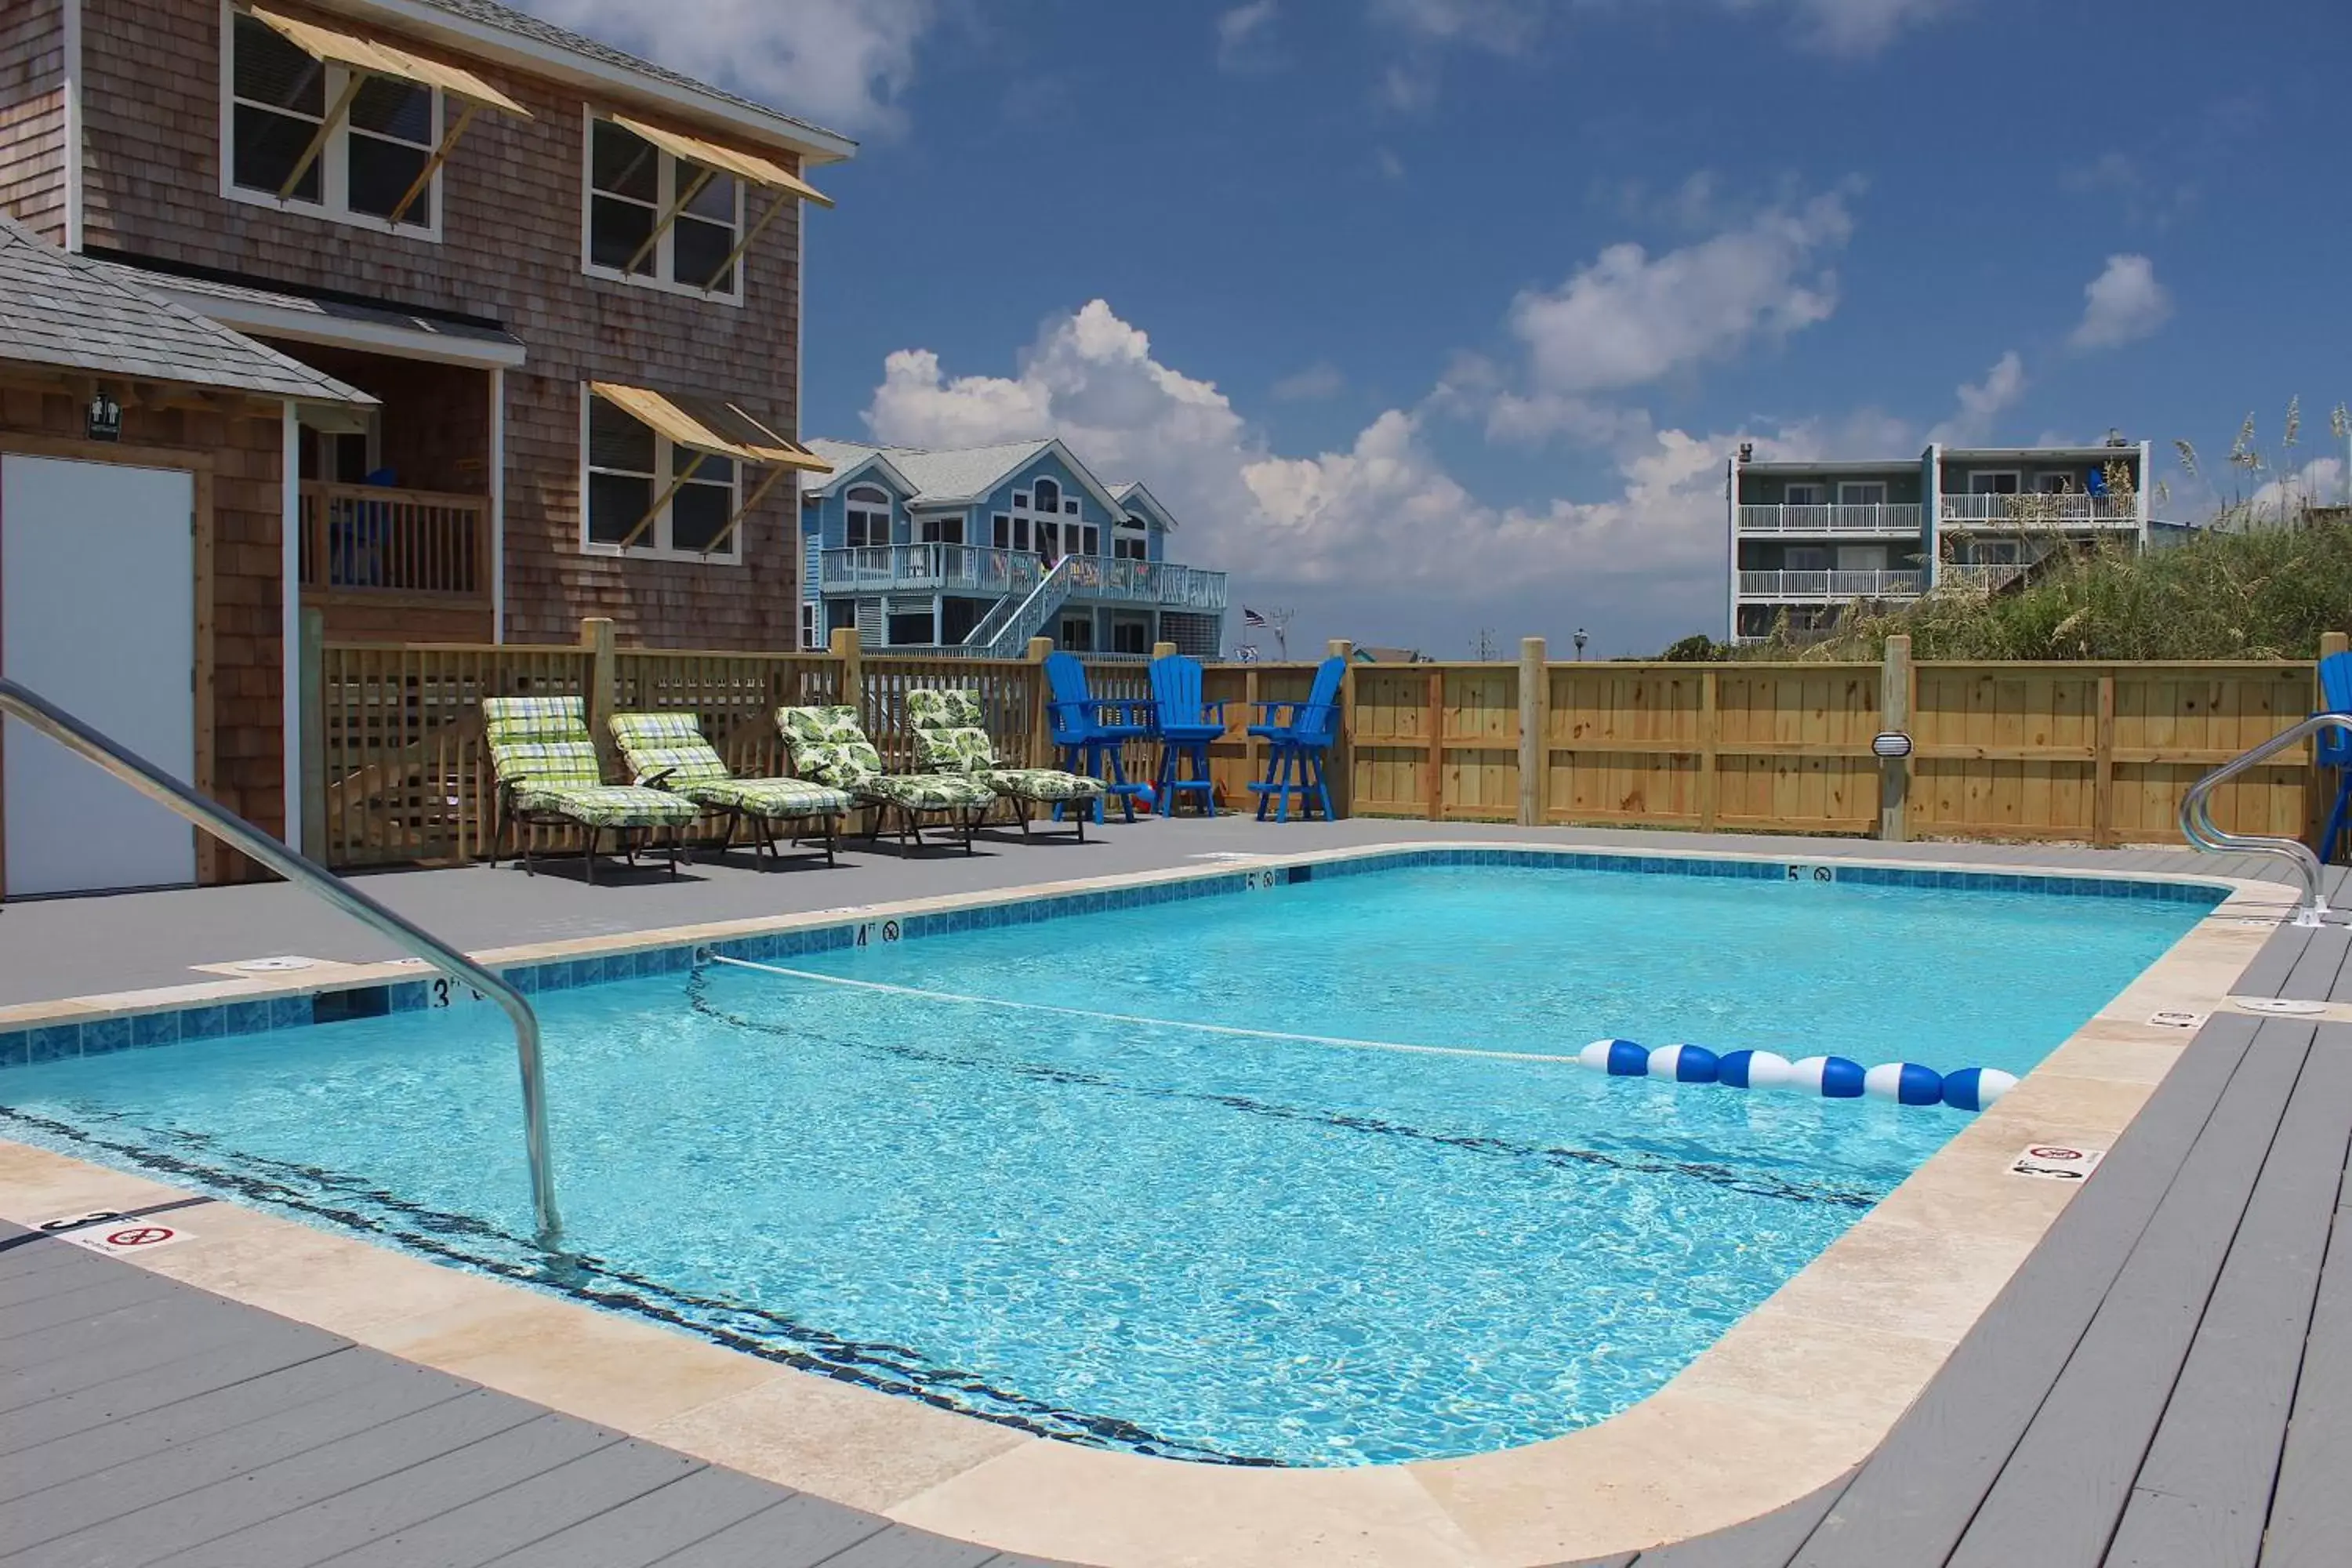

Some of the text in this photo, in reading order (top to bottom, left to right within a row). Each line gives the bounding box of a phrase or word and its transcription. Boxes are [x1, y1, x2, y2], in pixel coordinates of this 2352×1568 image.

[1788, 865, 1798, 880] 5
[434, 978, 450, 1007] 3
[2013, 1166, 2083, 1178] 3
[40, 1210, 119, 1231] 3
